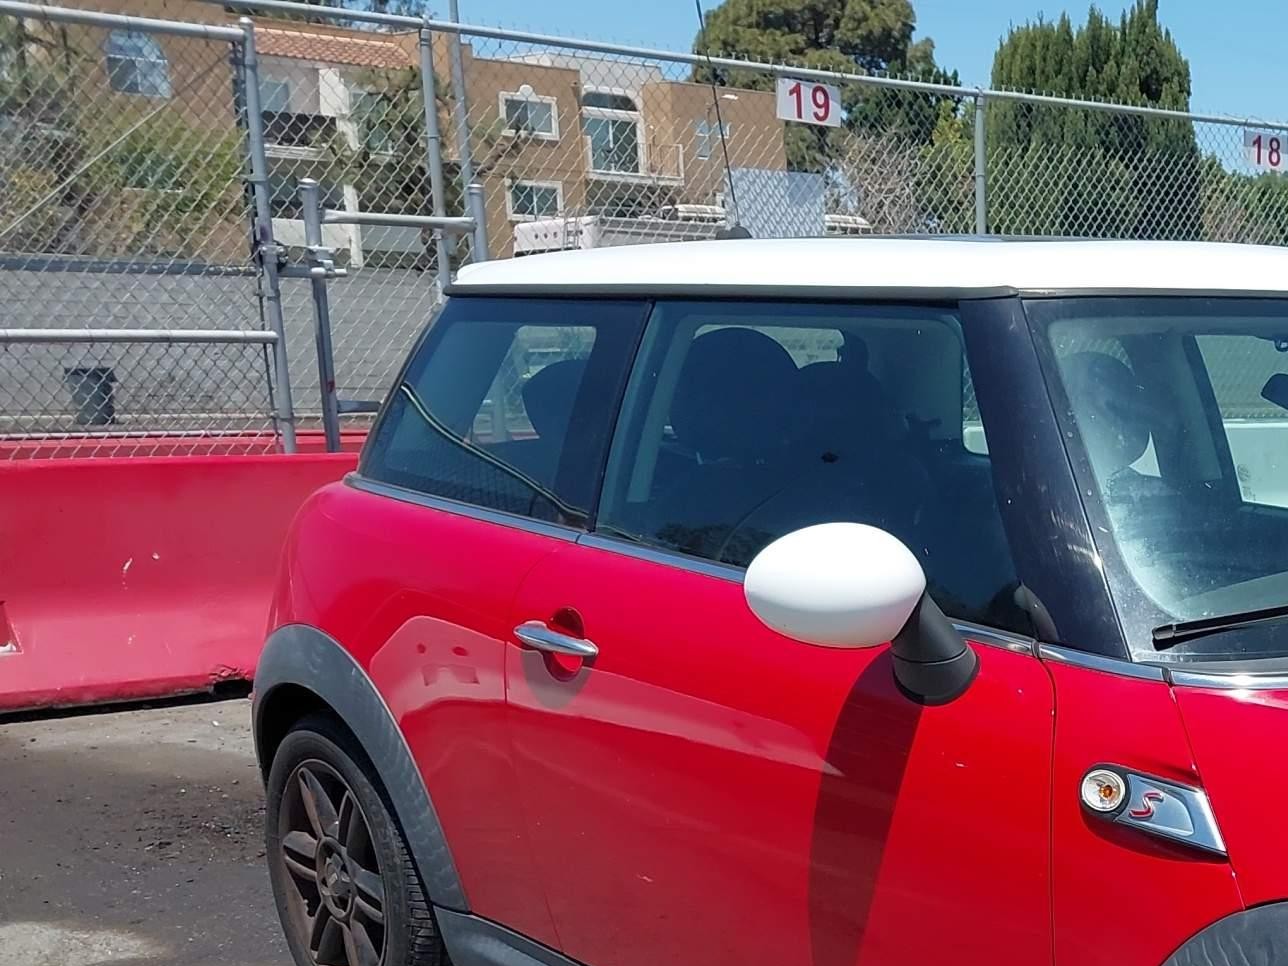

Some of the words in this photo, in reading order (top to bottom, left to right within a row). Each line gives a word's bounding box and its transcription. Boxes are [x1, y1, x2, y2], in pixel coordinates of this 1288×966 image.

[788, 81, 830, 122] 19
[1252, 134, 1281, 167] 18
[1128, 791, 1165, 821] S
